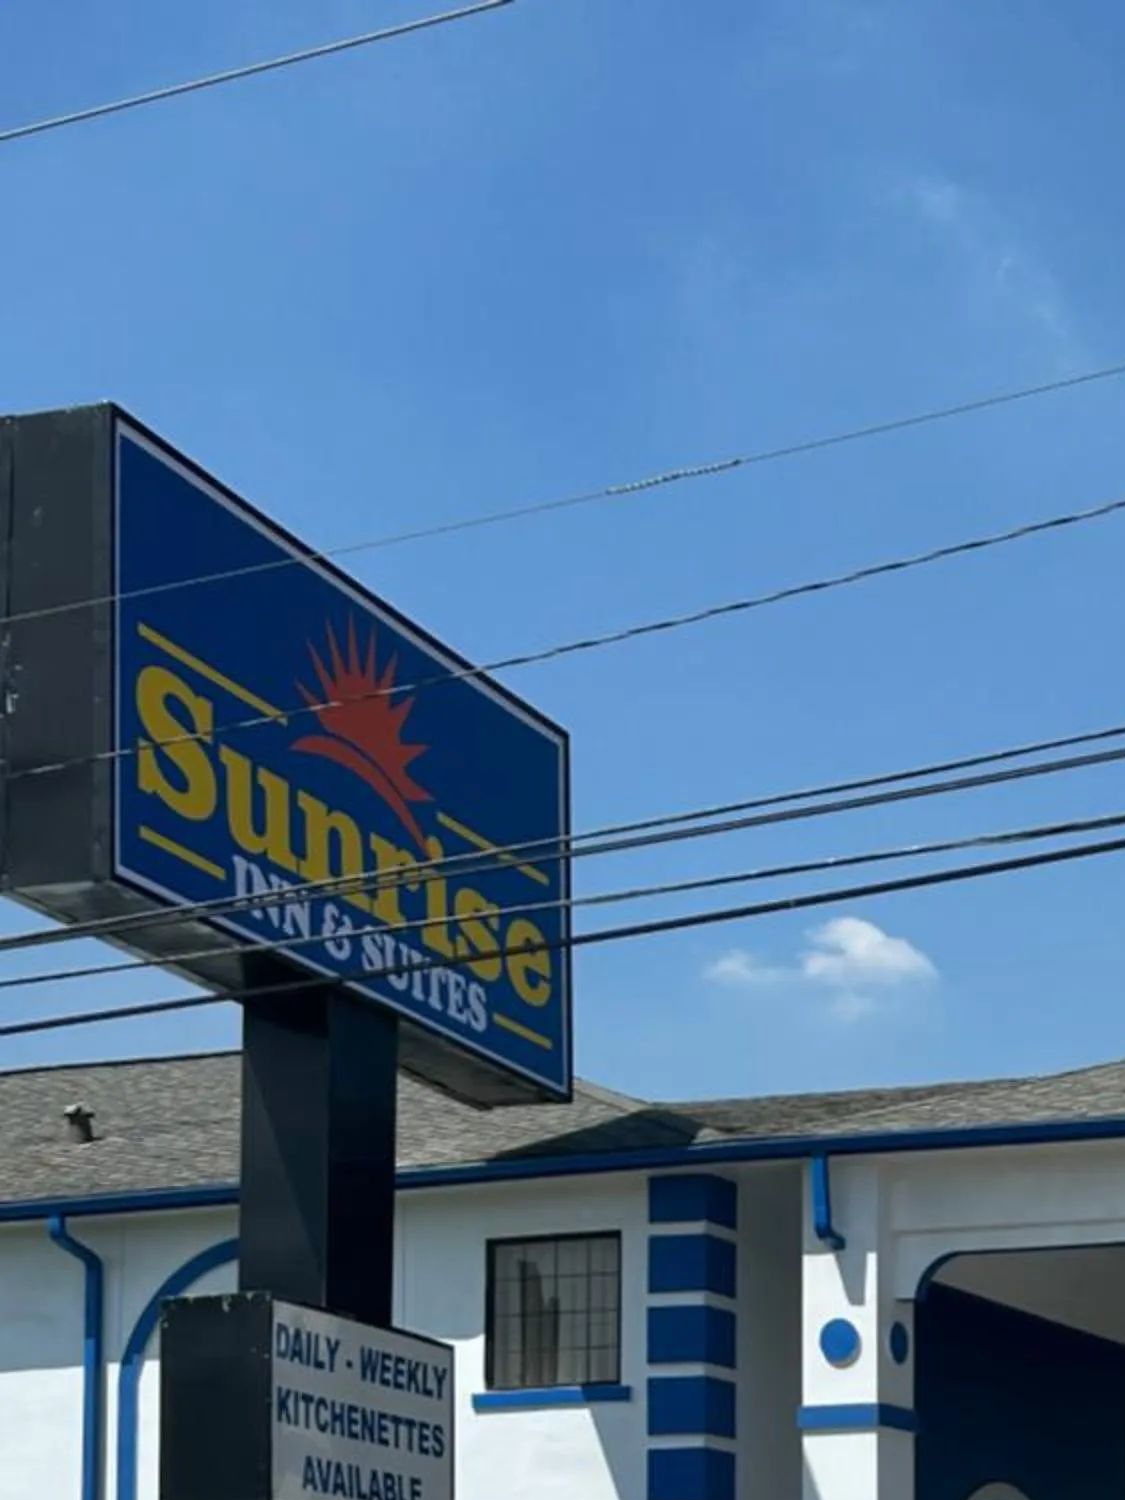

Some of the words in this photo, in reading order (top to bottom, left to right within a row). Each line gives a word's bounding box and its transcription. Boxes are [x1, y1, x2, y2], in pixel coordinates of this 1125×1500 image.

[136, 665, 553, 1007] Sunrise
[233, 855, 312, 940] INN
[322, 902, 353, 961] &
[361, 926, 488, 1033] SUITES
[276, 1322, 341, 1373] DAILY
[360, 1346, 448, 1400] WEEKLY
[276, 1386, 445, 1459] KITCHENETTES
